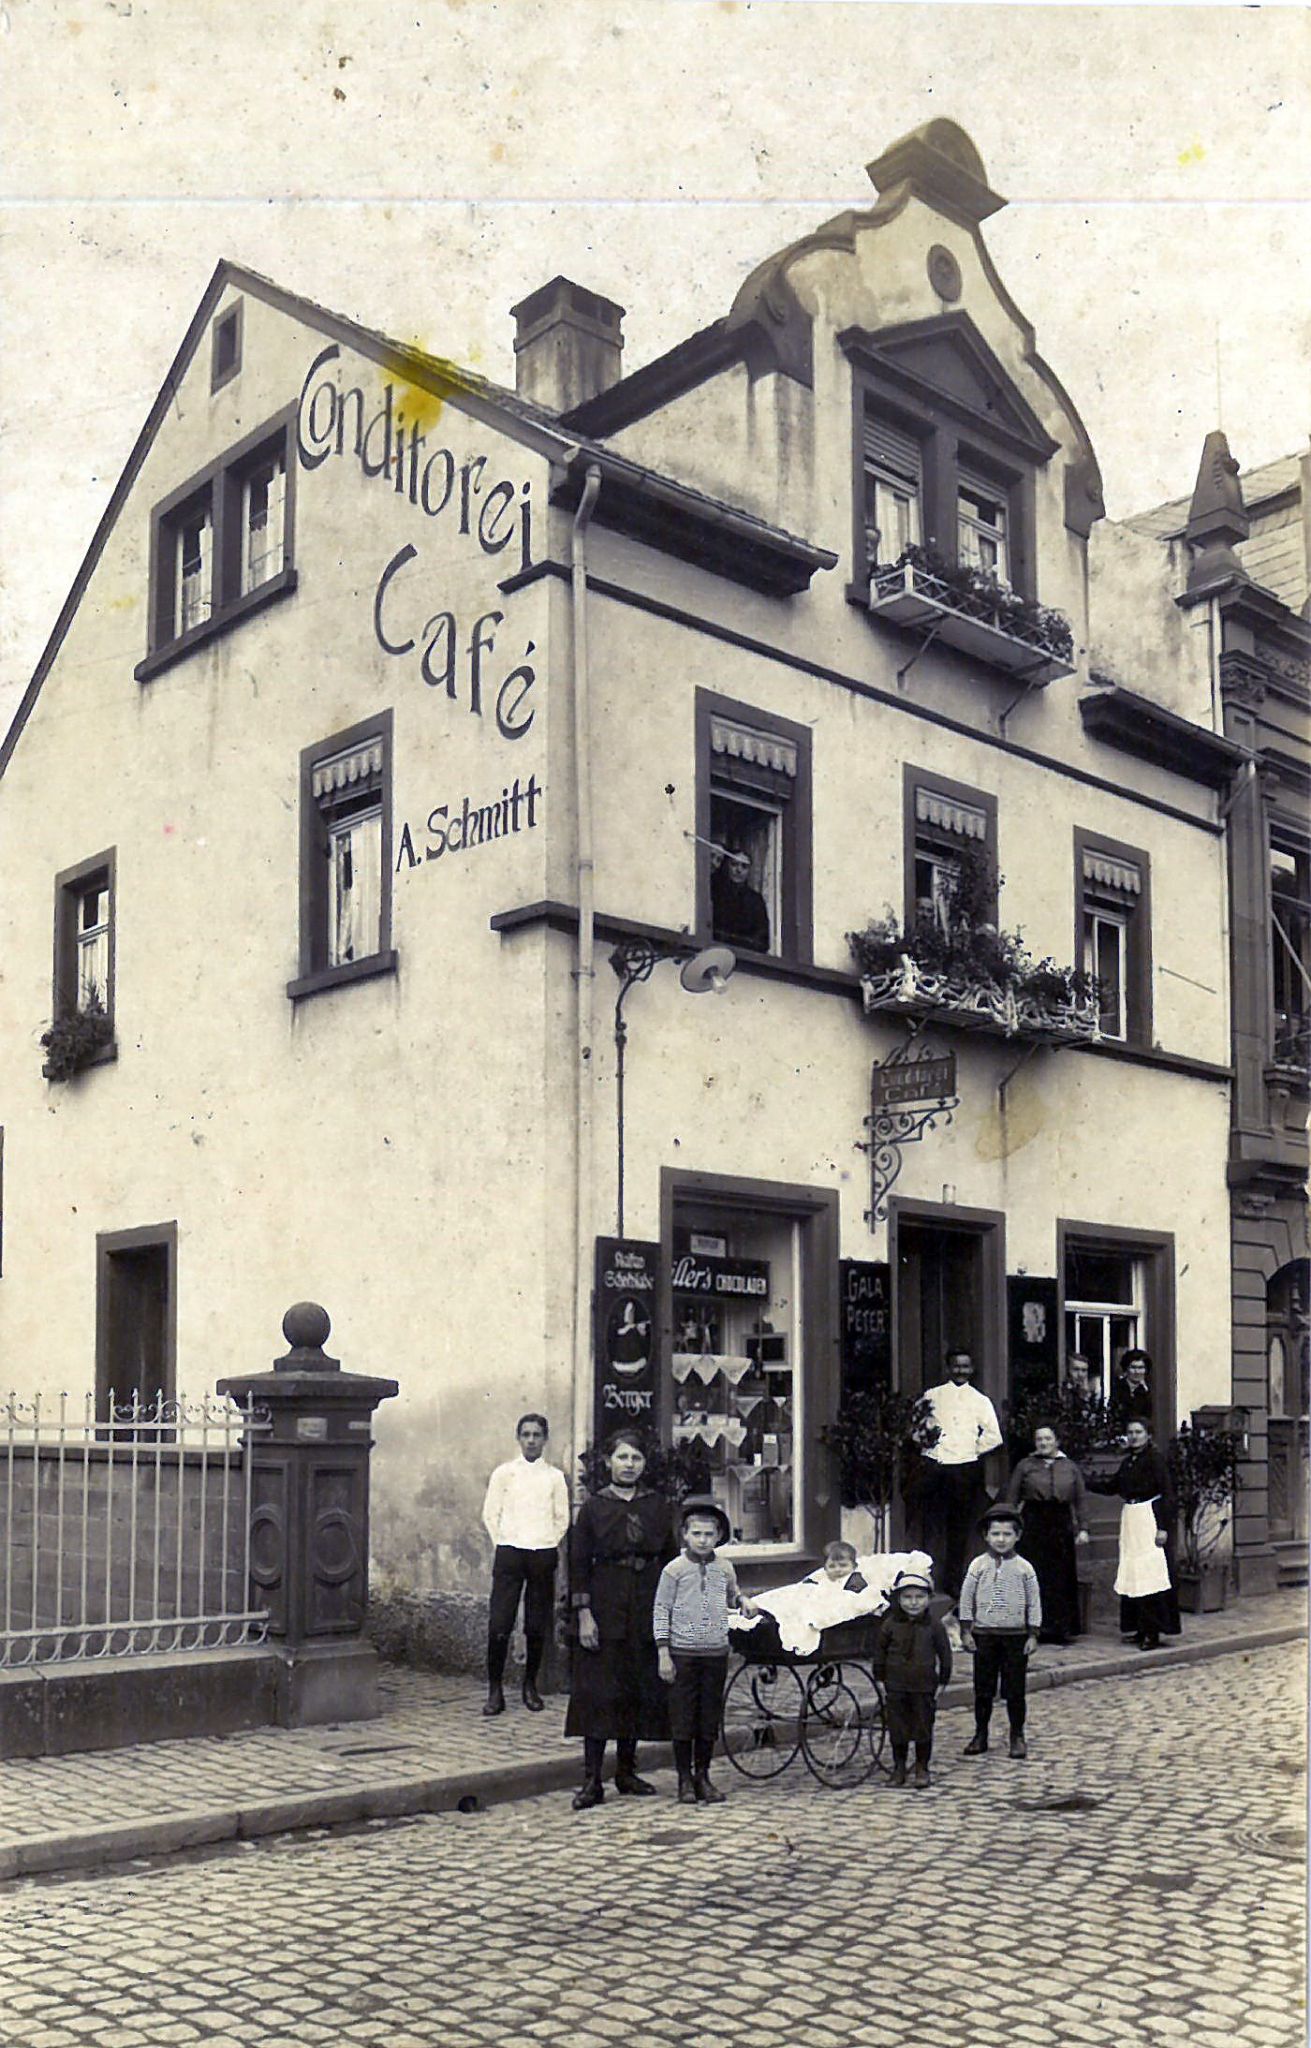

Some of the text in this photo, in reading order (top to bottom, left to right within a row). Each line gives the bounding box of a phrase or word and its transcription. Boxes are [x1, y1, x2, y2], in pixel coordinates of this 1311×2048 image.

[299, 344, 532, 571] Conditorei
[373, 543, 536, 741] Café
[395, 773, 542, 873] A. Schmitt
[671, 1256, 712, 1290] iller's
[848, 1268, 884, 1302] GALA
[846, 1304, 886, 1333] PETER
[602, 1383, 654, 1417] Berger
